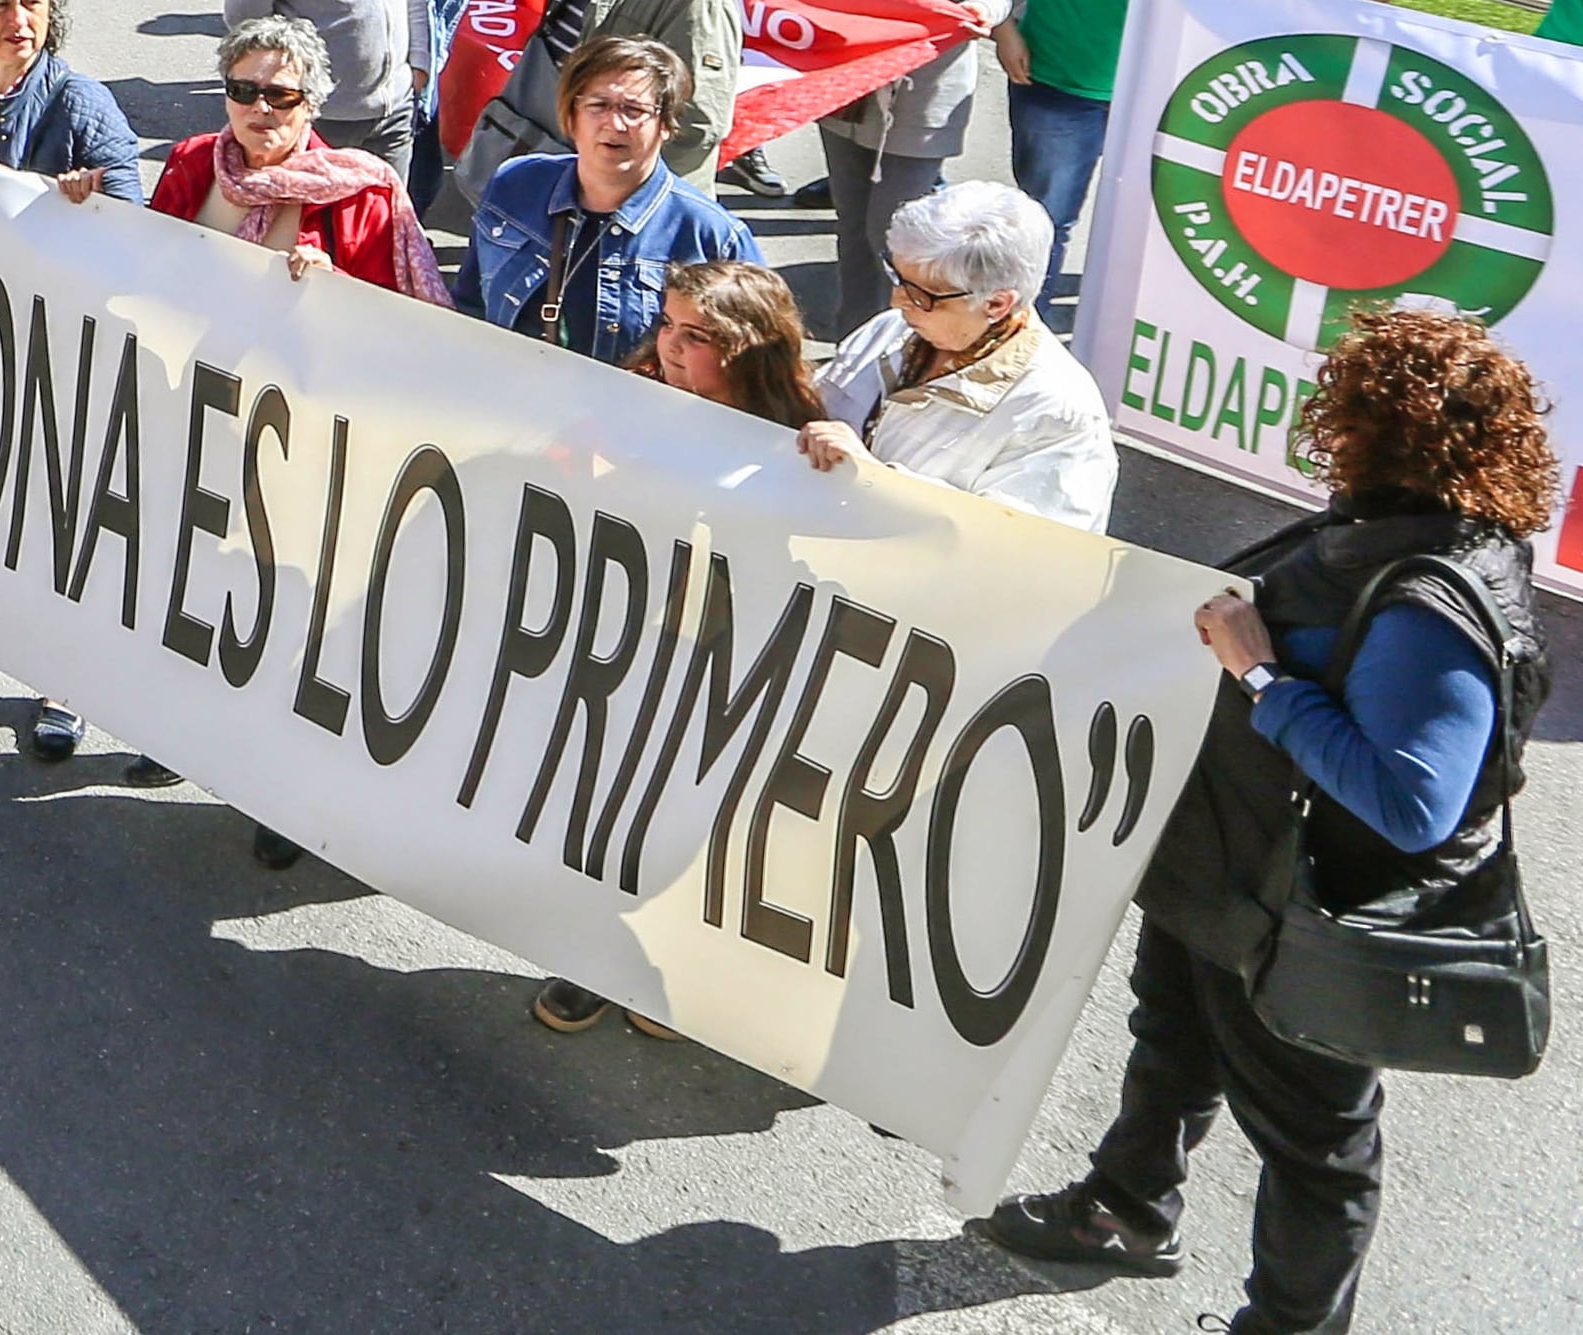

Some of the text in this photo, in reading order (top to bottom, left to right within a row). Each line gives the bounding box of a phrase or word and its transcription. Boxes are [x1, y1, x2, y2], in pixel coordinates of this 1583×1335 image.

[1190, 52, 1529, 216] OBRA SOCIAL
[1232, 151, 1450, 243] ELDAPETRER
[1173, 200, 1260, 307] P.A.H.
[161, 359, 291, 689] ES
[294, 414, 465, 767] LO
